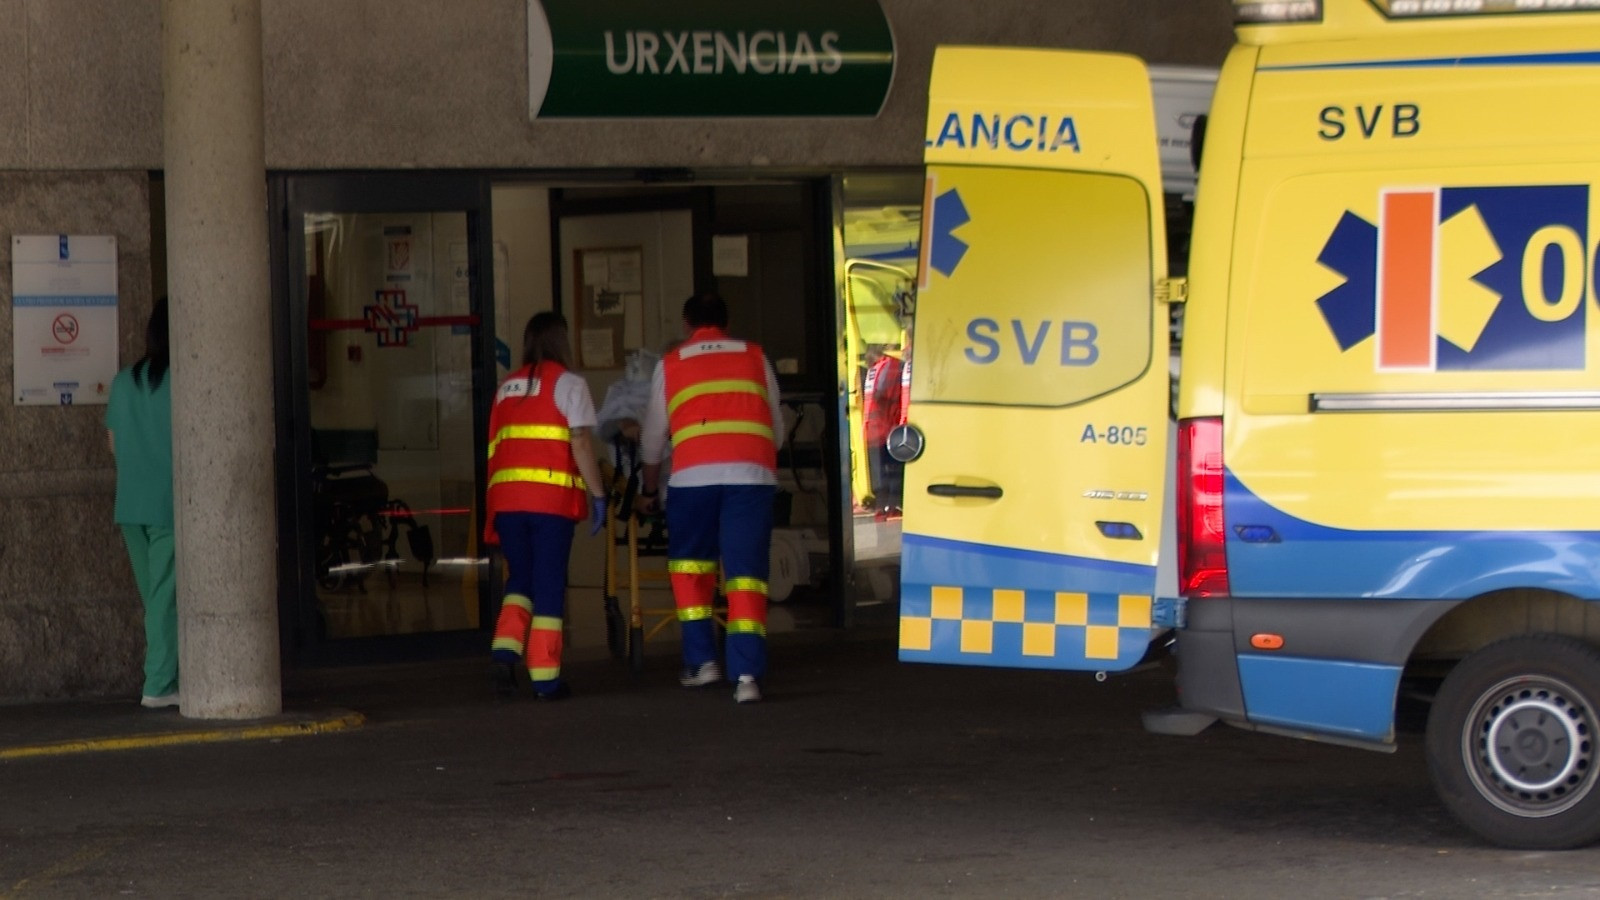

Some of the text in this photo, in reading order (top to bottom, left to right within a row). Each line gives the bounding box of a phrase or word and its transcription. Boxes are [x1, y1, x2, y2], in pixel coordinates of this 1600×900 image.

[604, 31, 843, 75] URXENCIAS
[1318, 103, 1420, 141] SVB
[1521, 224, 1600, 322] 0
[964, 317, 1100, 367] SVB
[1080, 424, 1147, 446] A-805
